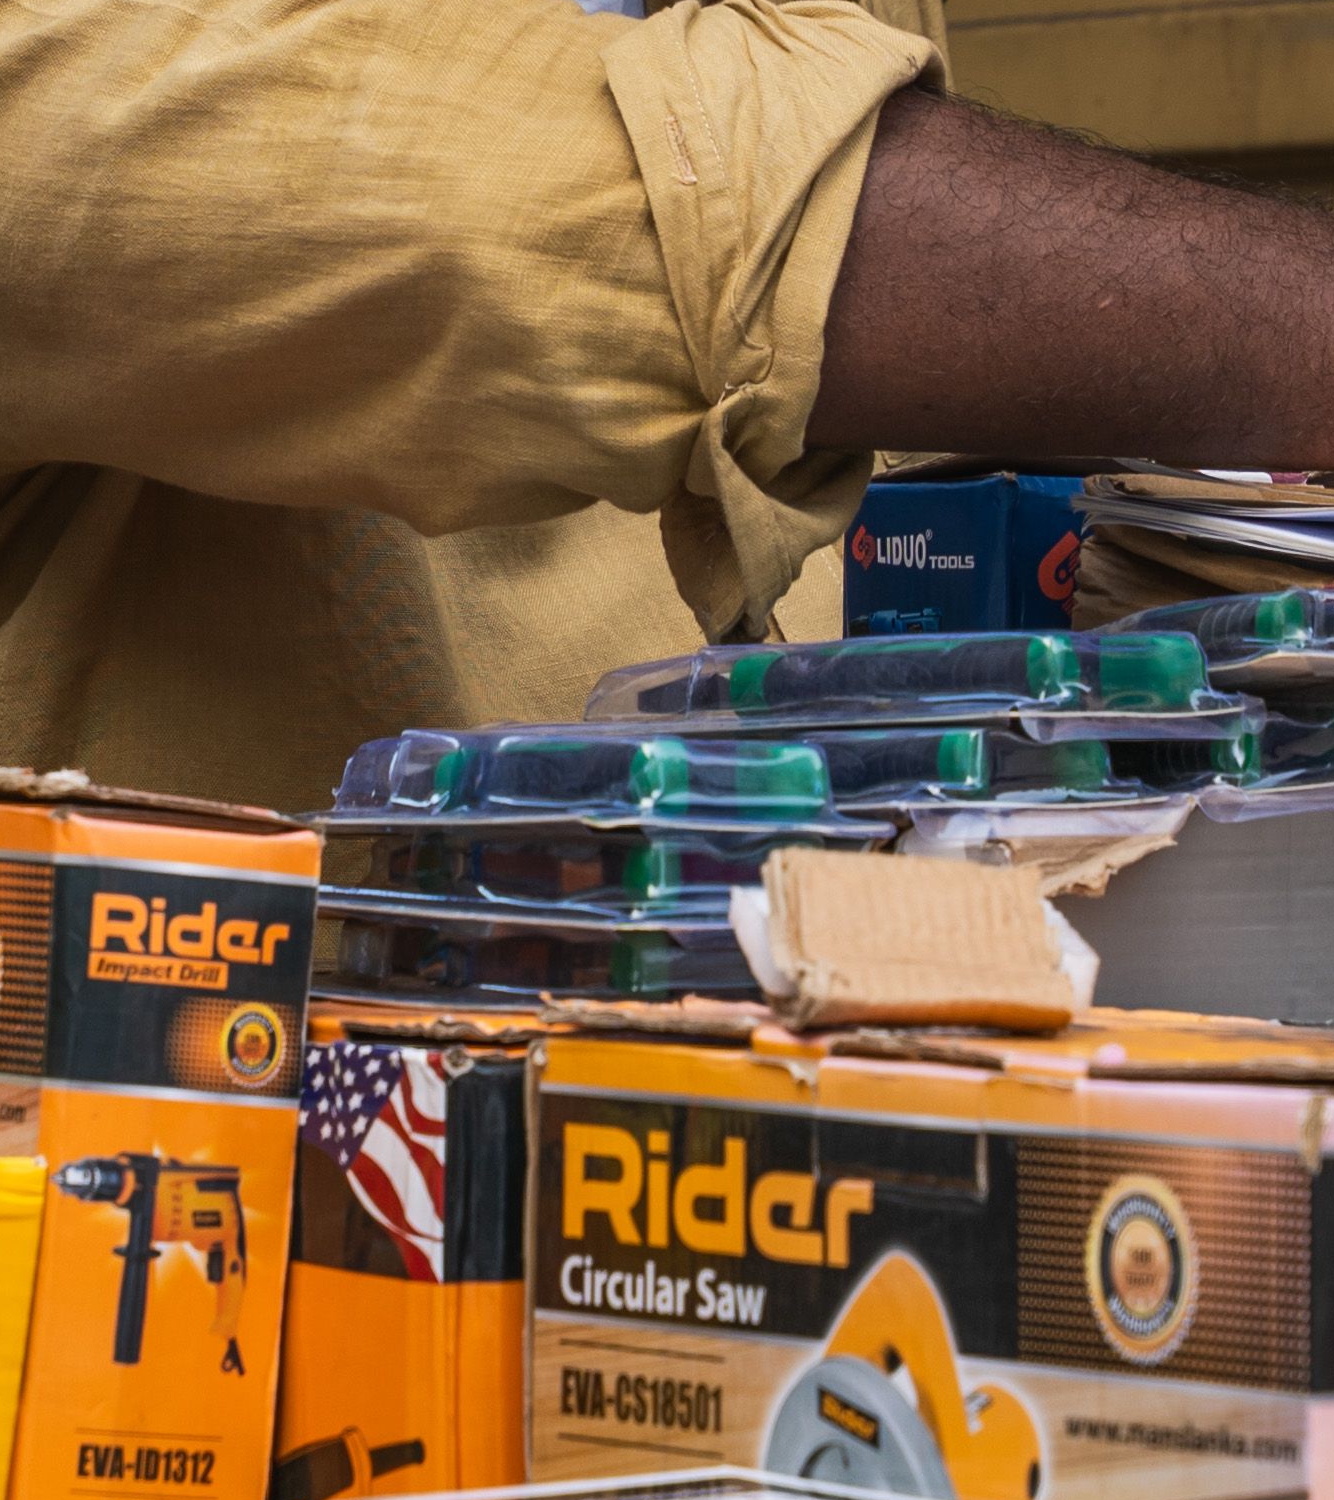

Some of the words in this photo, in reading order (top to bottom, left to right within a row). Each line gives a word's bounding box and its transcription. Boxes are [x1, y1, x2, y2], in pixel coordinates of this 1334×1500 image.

[876, 534, 928, 571] LIDUO
[929, 553, 976, 571] TOOLS
[88, 892, 292, 966] Rider
[94, 957, 173, 984] Impact
[179, 963, 222, 987] Drill
[560, 1121, 874, 1269] Rider
[559, 1253, 690, 1316] Circular
[695, 1267, 767, 1327] Saw
[560, 1366, 725, 1434] EVA-CS18501
[76, 1443, 216, 1485] EVA-ID1312
